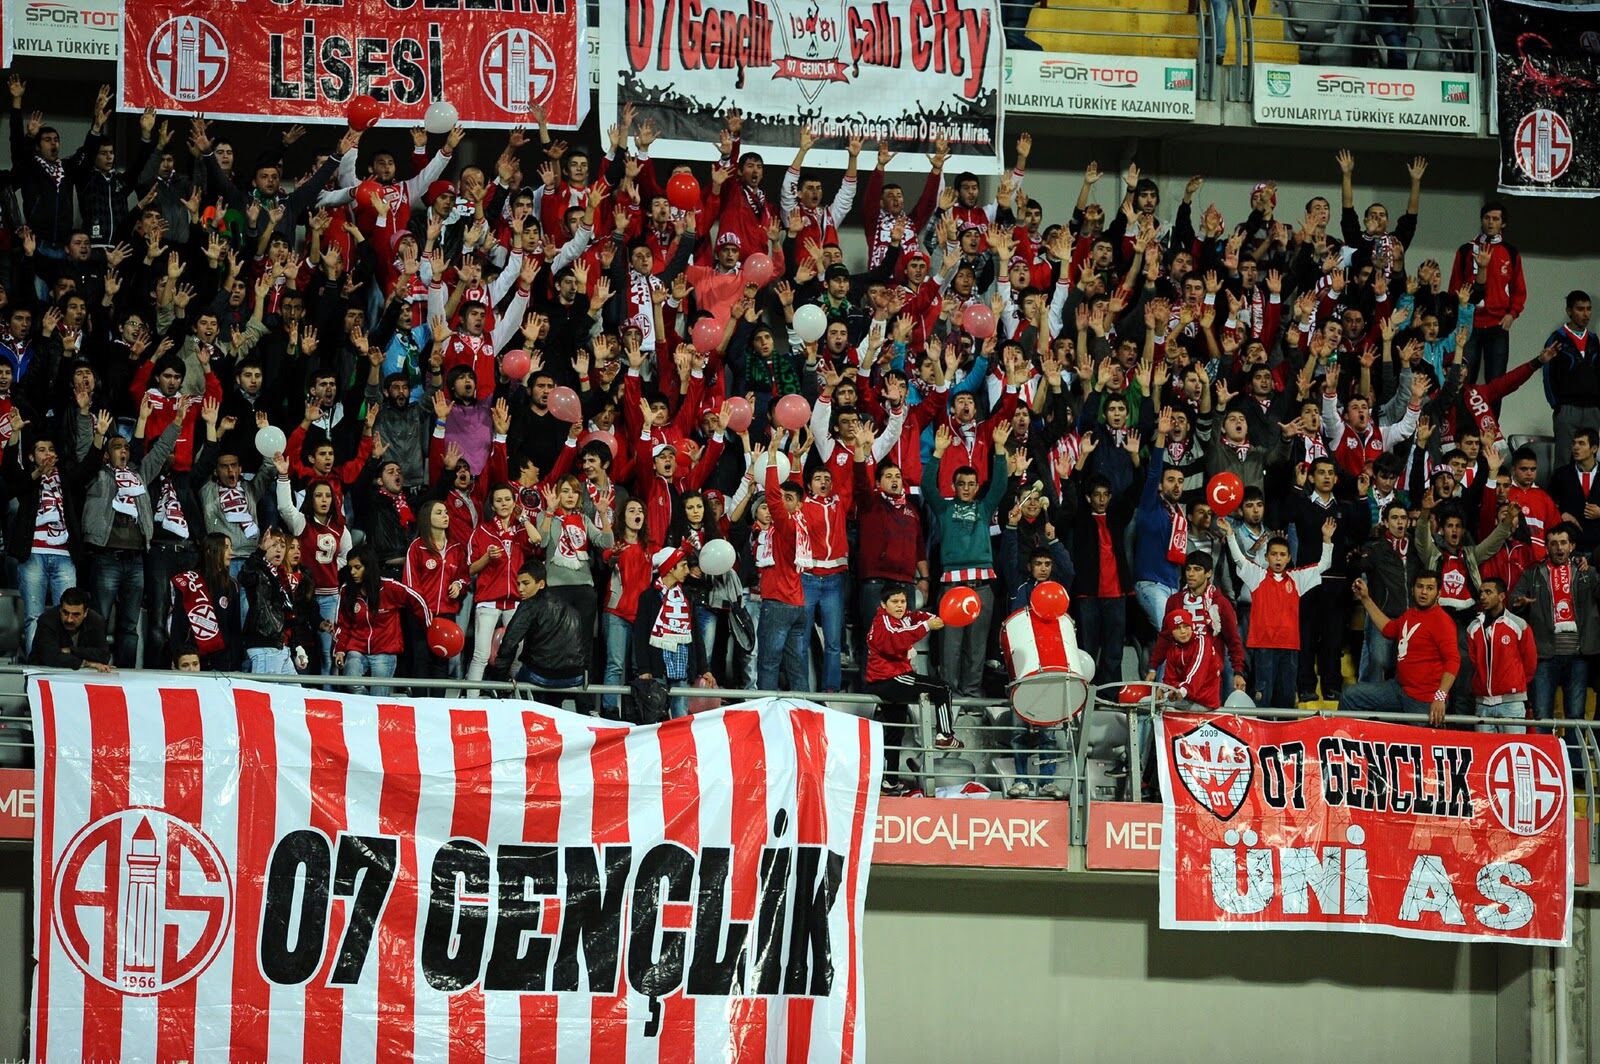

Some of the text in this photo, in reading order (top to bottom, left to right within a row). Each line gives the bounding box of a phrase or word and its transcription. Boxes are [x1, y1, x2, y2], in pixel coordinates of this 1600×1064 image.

[57, 37, 110, 56] TÜRKİYE
[910, 0, 991, 99] City
[269, 18, 444, 105] LİSESİ
[1068, 94, 1117, 111] TÜRKİYE
[1121, 100, 1194, 115] KAZANIYOR.
[1261, 106, 1471, 128] OYUNLARIYLA TÜRKİYE KAZANIYOR.
[890, 119, 918, 139] Kalan
[1199, 729, 1219, 738] 2009
[1257, 736, 1474, 820] 07 GENÇLİK
[1211, 791, 1227, 806] 07
[1516, 825, 1533, 834] 1966
[1210, 824, 1369, 916] ÜNİ
[260, 807, 846, 1038] 07 GENÇLİK
[121, 974, 157, 990] 1966
